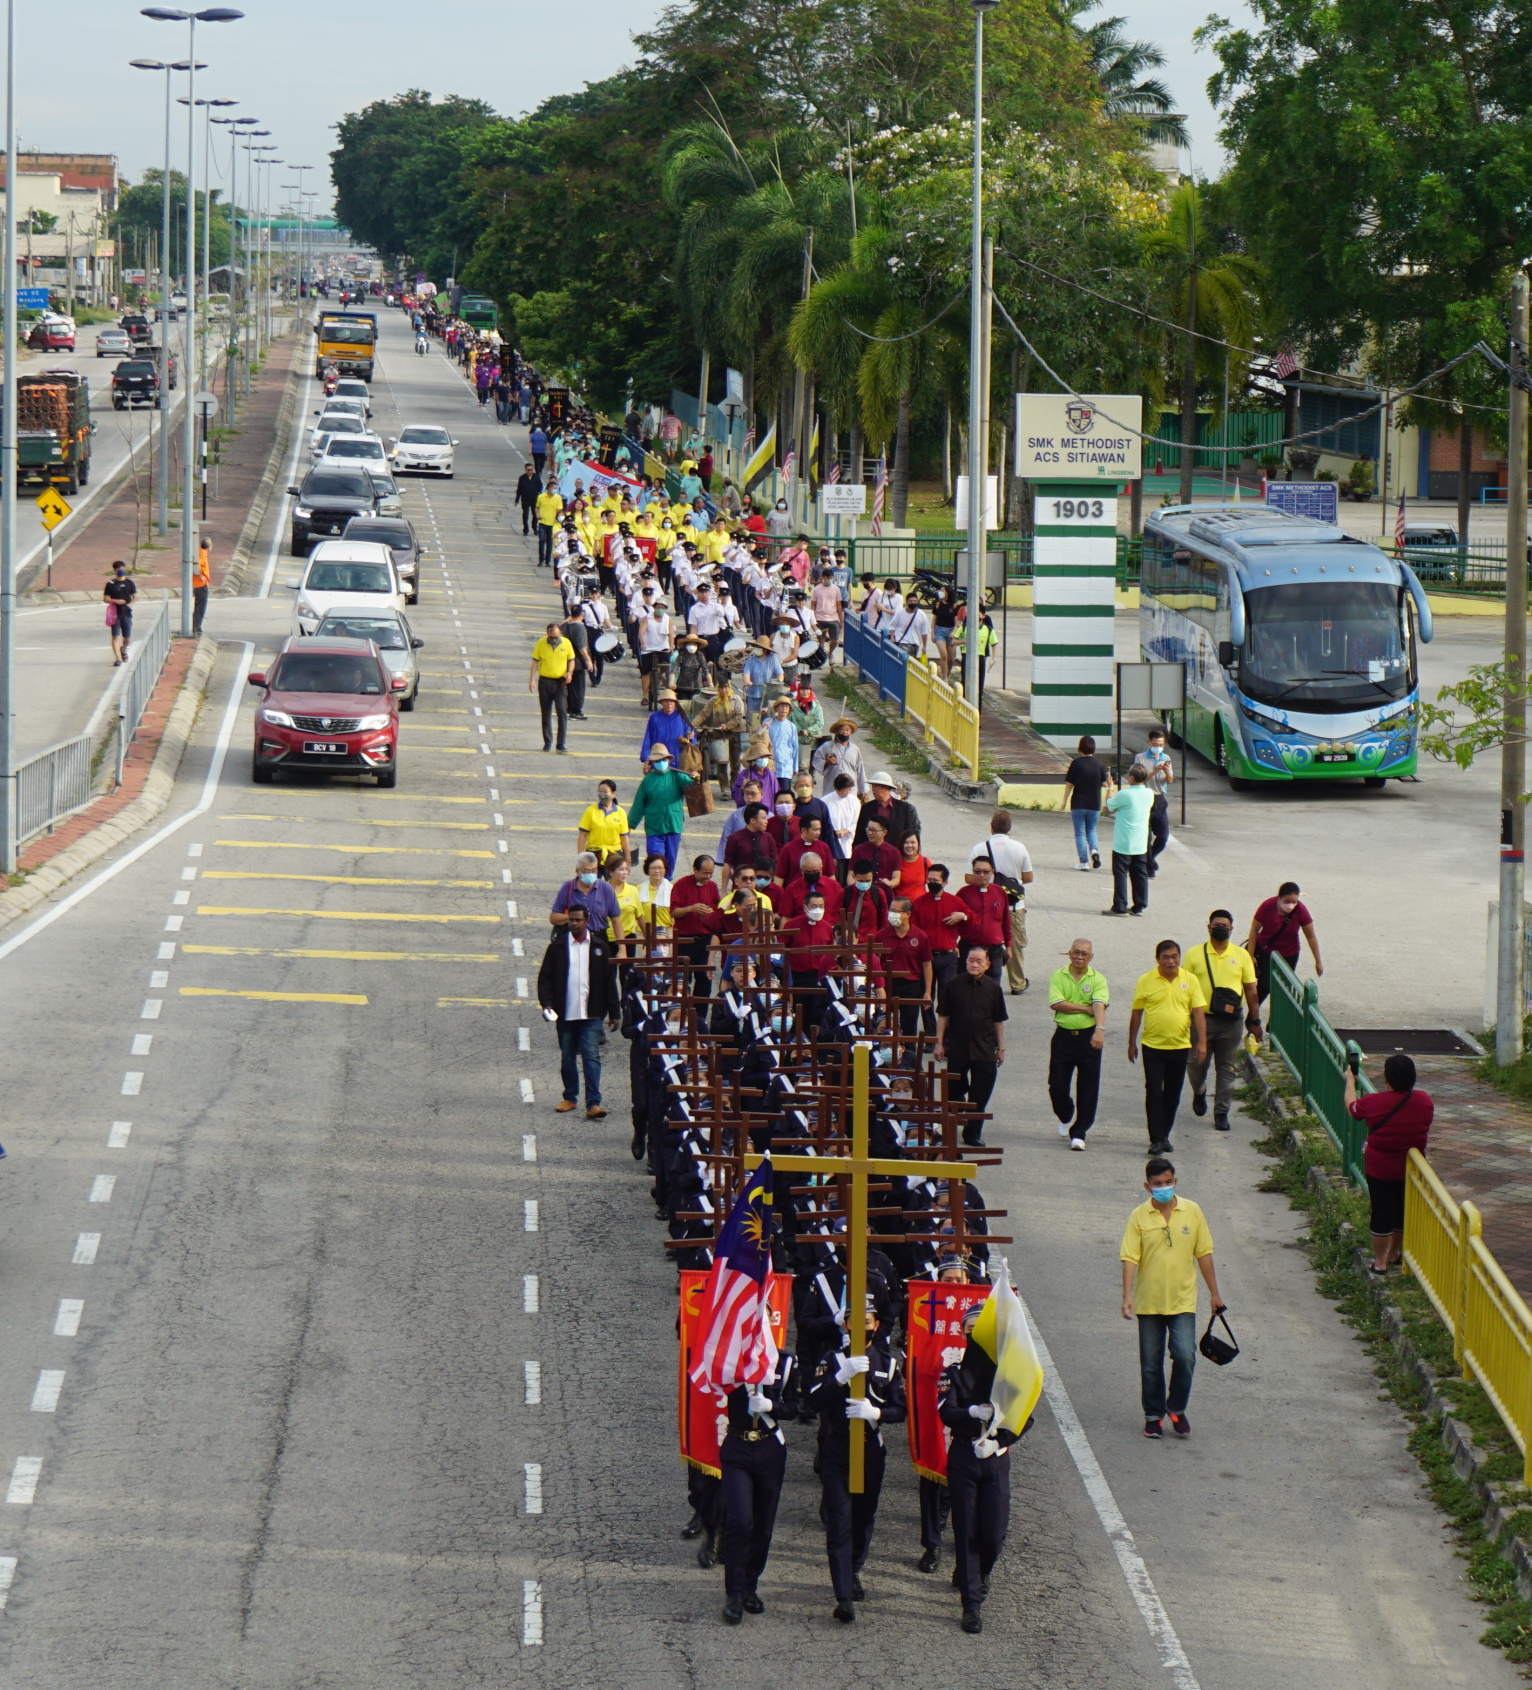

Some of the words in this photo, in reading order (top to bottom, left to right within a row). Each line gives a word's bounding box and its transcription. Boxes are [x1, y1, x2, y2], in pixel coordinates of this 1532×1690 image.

[1027, 437, 1055, 449] SMK
[1061, 438, 1132, 449] METHODIST
[1034, 452, 1060, 463] ACS
[1067, 452, 1125, 463] SITIAWAN
[1053, 500, 1104, 519] 1903
[313, 744, 327, 752] BCV
[329, 744, 337, 752] 18
